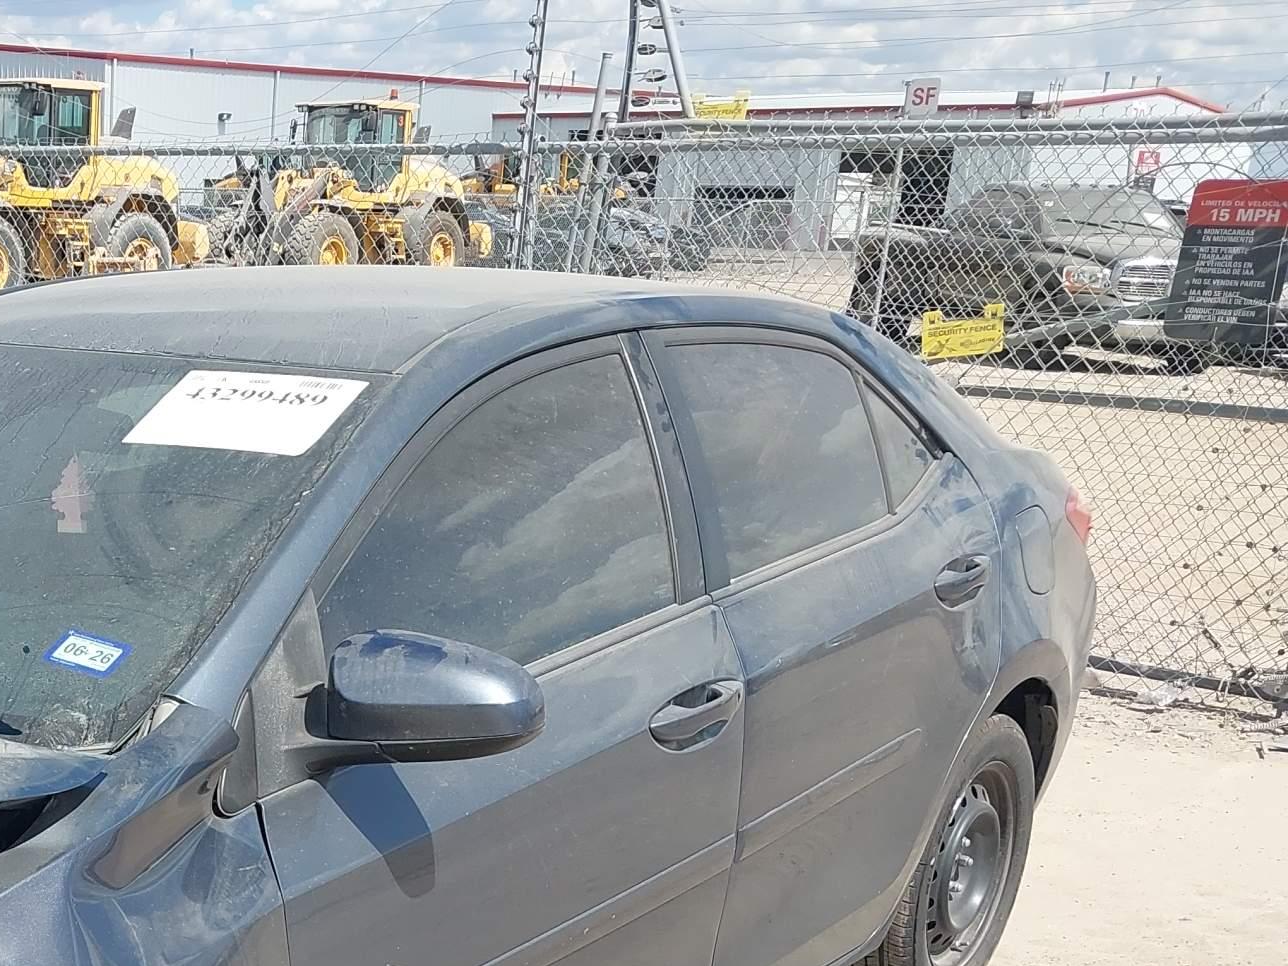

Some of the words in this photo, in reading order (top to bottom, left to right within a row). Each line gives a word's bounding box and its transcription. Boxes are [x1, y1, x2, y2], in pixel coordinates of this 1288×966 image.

[912, 87, 937, 106] SF
[398, 114, 404, 128] 3
[1210, 208, 1231, 221] 15
[1236, 208, 1281, 223] MPH
[1203, 228, 1256, 236] MONTACARGAS
[1212, 279, 1239, 287] VENDEN
[1239, 280, 1266, 288] PARTES
[1202, 289, 1213, 297] NO
[928, 327, 968, 338] SECURITY
[969, 324, 997, 333] FENCE
[185, 386, 328, 406] 43299489
